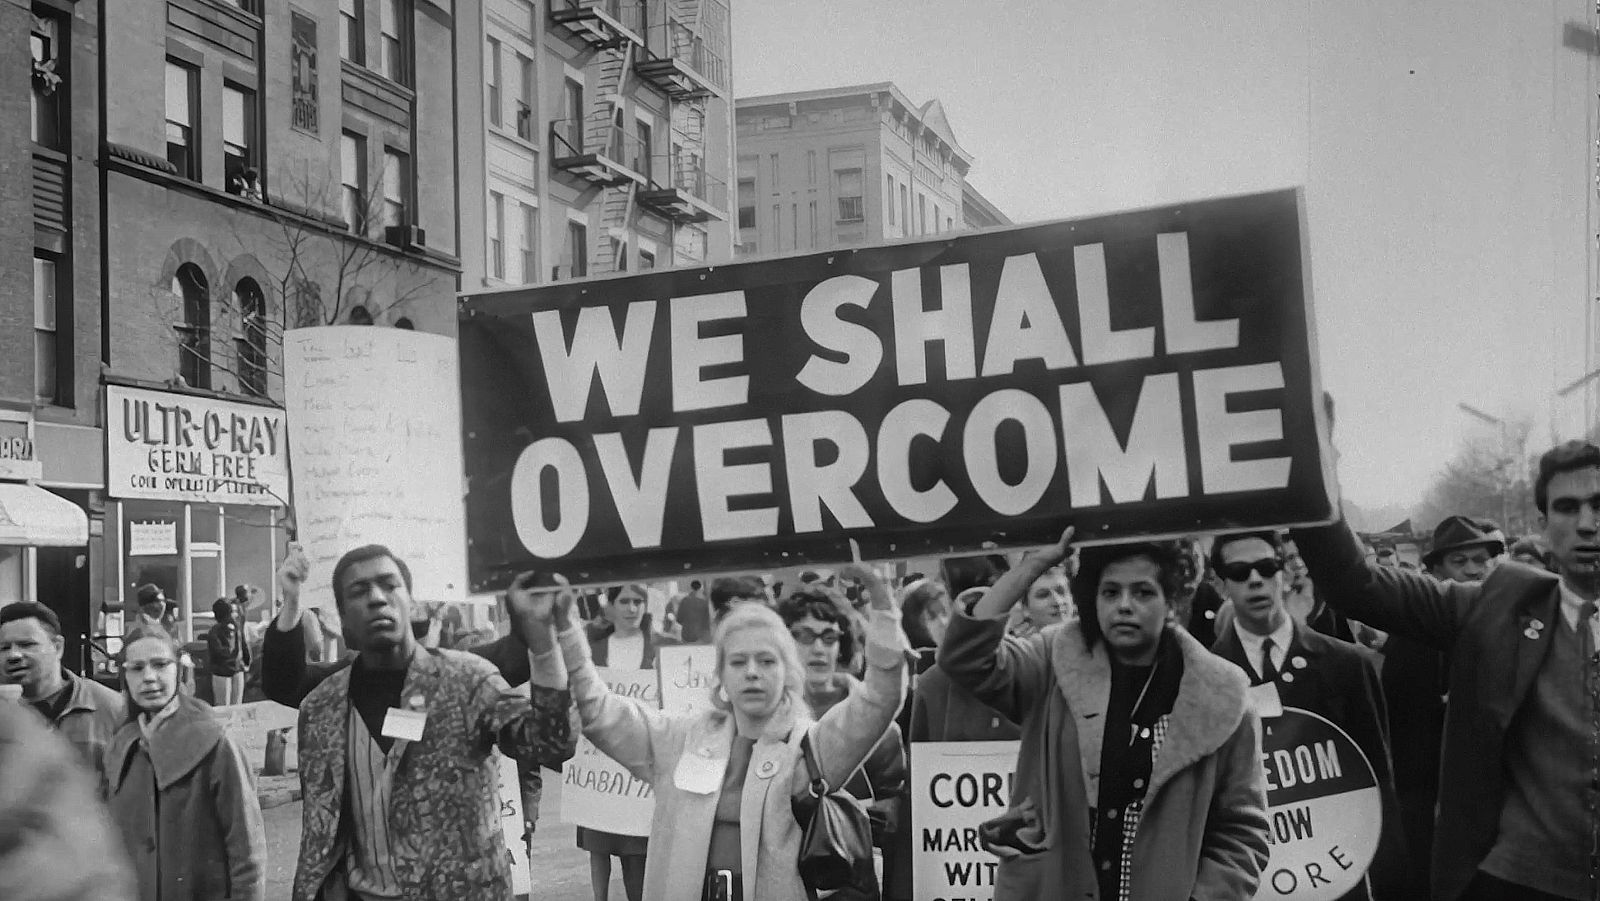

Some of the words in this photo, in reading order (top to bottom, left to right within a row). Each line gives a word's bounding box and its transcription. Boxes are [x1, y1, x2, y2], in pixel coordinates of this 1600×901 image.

[531, 290, 750, 423] WE
[795, 231, 1240, 396] SHALL
[212, 453, 257, 479] FREE
[511, 361, 1293, 559] OVERCOME
[607, 682, 658, 701] ARC
[1262, 739, 1342, 791] EDOM
[922, 828, 981, 852] MAR
[1267, 806, 1313, 845] OW
[944, 862, 999, 886] WIT
[1271, 845, 1354, 895] ORE
